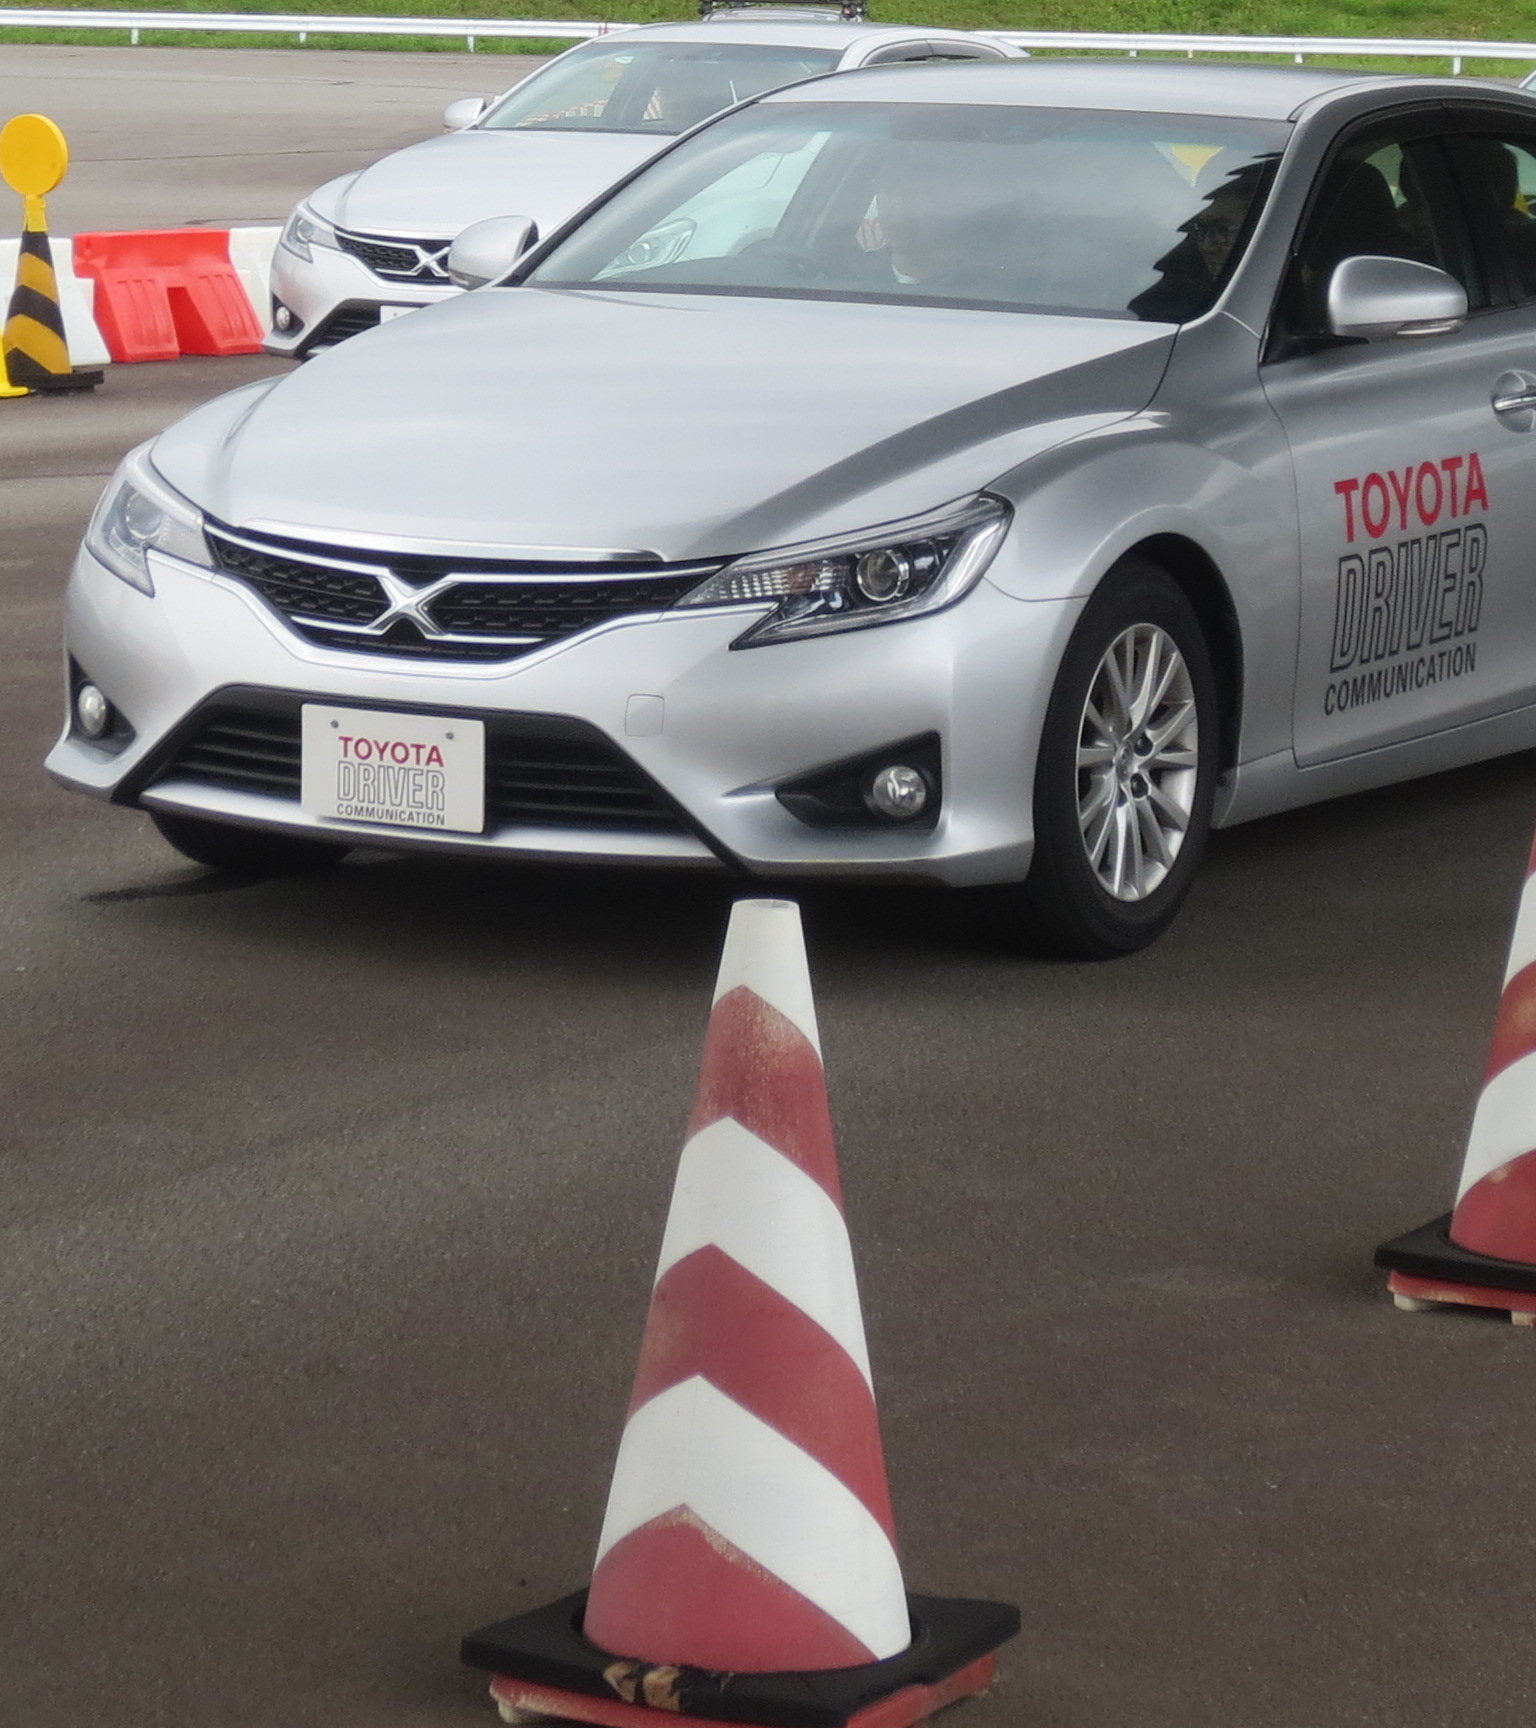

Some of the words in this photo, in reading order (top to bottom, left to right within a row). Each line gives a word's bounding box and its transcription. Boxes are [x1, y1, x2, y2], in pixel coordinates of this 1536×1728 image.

[1334, 452, 1489, 543] TOYOTA
[1329, 523, 1488, 674] DRIVER
[1324, 642, 1477, 716] COMMUNICATION
[338, 736, 445, 768] TOYOTA
[336, 803, 446, 826] COMMUNICATION
[337, 760, 446, 812] DRIVER
